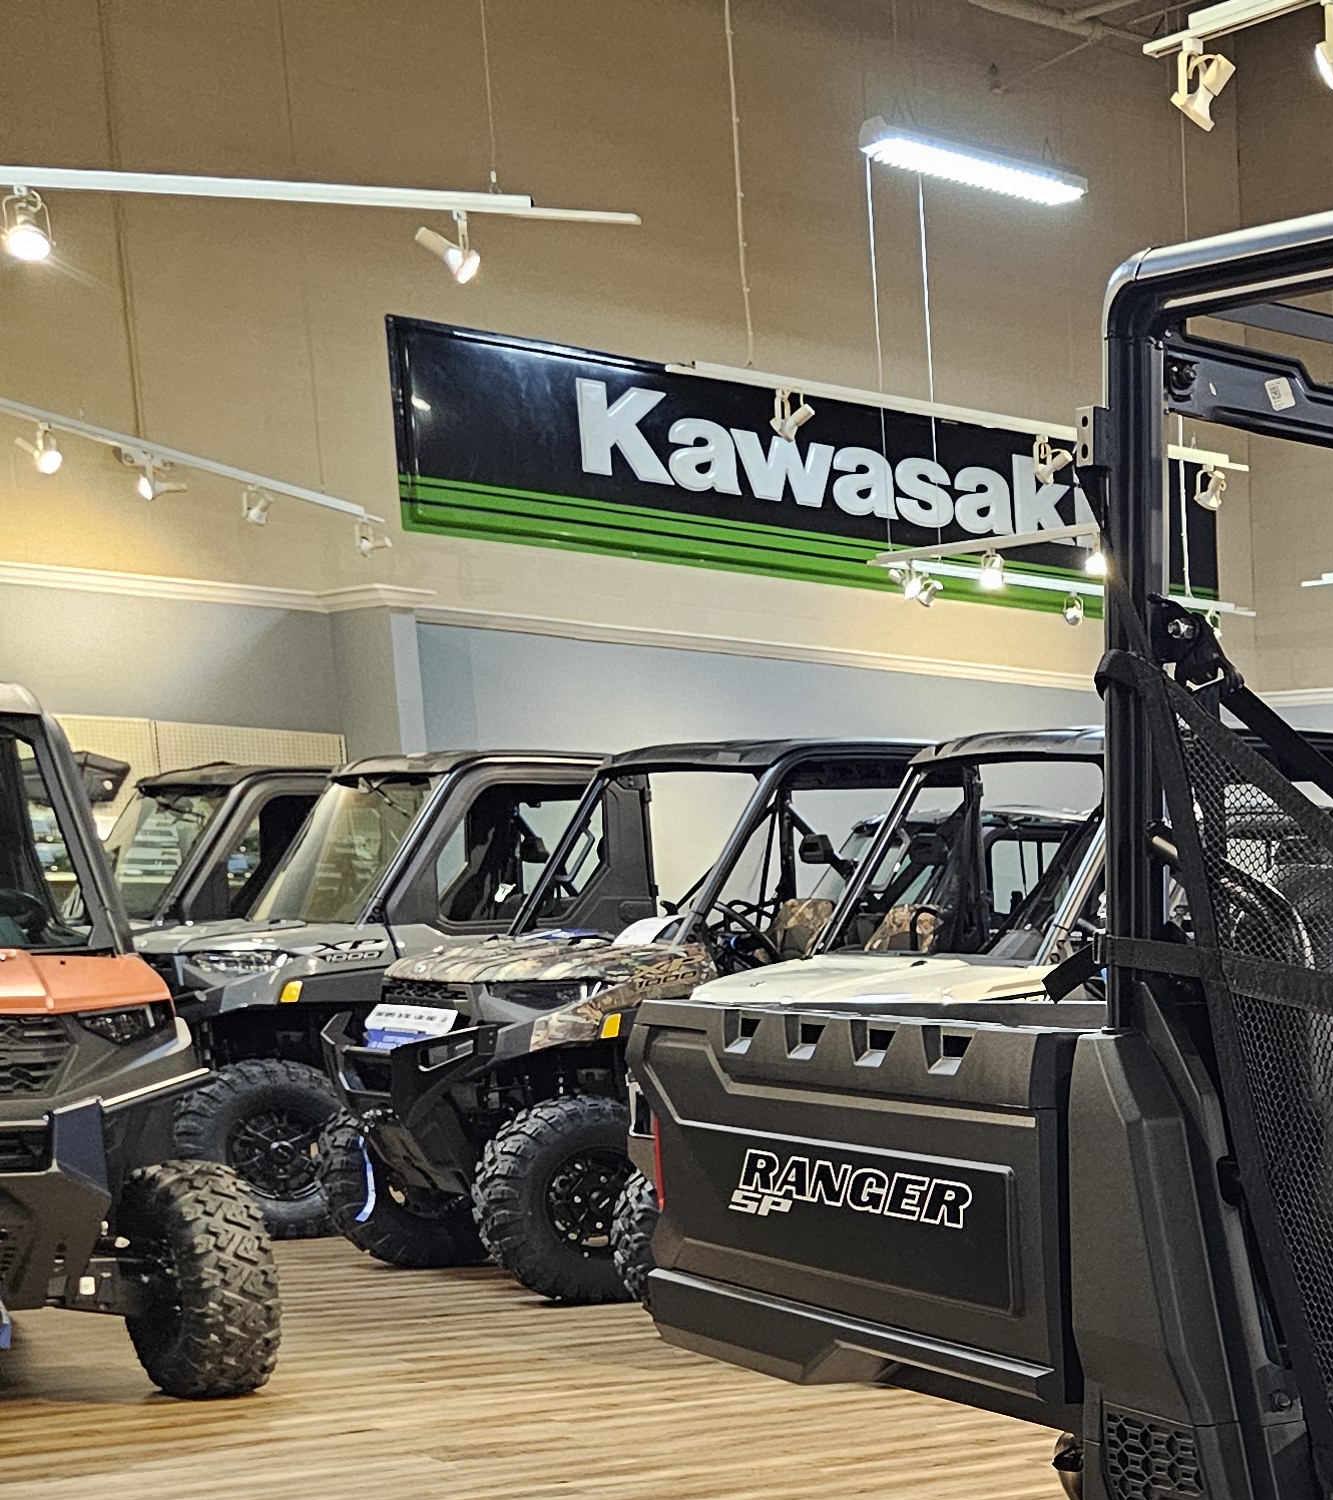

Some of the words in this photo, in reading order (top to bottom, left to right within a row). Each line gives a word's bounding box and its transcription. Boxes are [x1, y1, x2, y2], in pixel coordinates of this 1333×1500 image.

[314, 939, 384, 953] XP
[324, 951, 382, 963] 1000
[630, 954, 705, 980] XP
[637, 970, 698, 990] 1000
[739, 1149, 972, 1229] RANGER
[728, 1190, 793, 1217] SP
